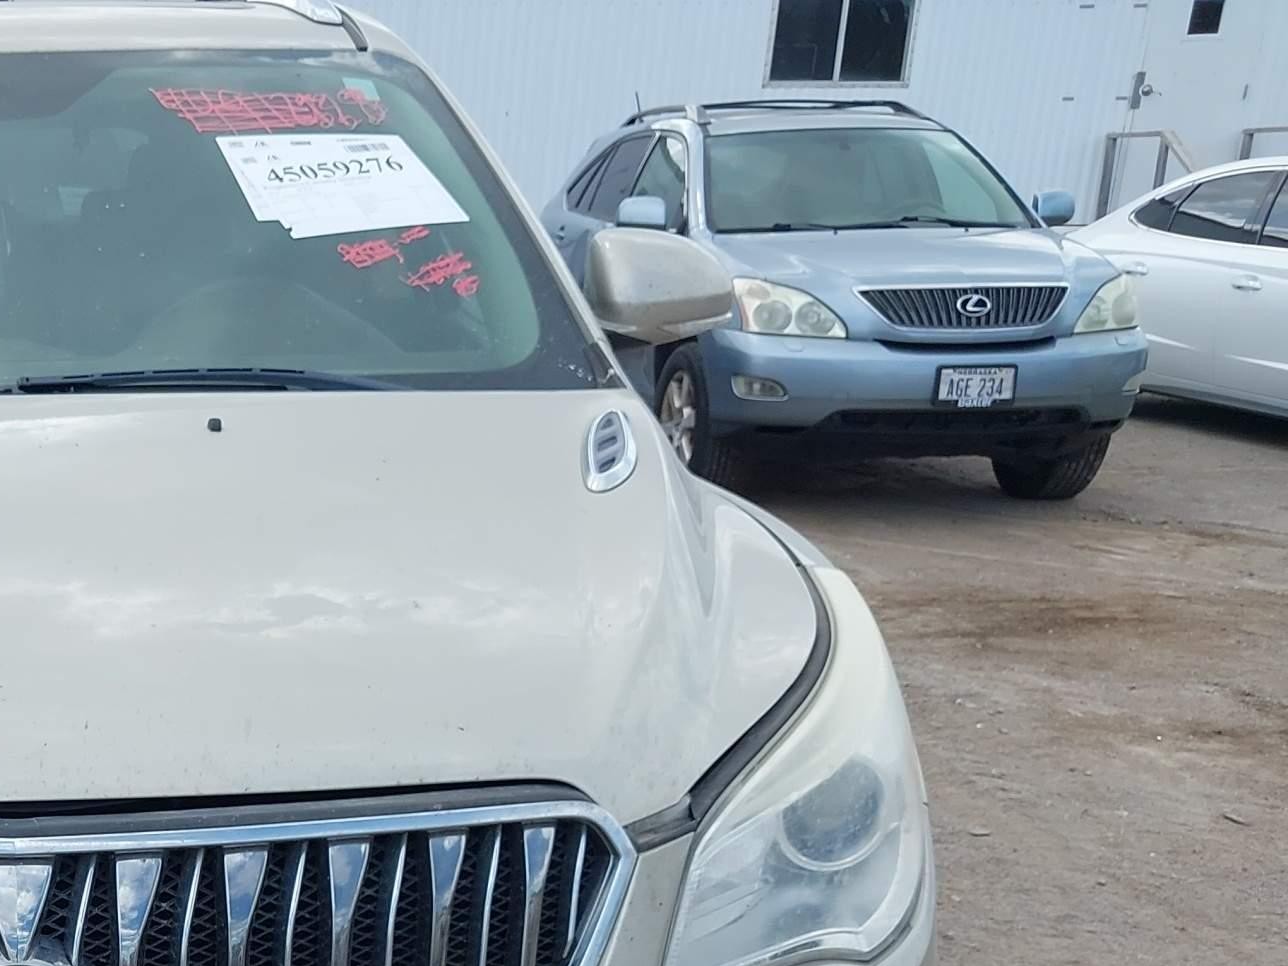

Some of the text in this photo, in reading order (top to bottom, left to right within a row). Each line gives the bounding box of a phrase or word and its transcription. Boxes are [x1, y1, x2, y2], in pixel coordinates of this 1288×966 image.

[267, 156, 403, 182] 45059276
[946, 377, 1004, 397] AGE 234
